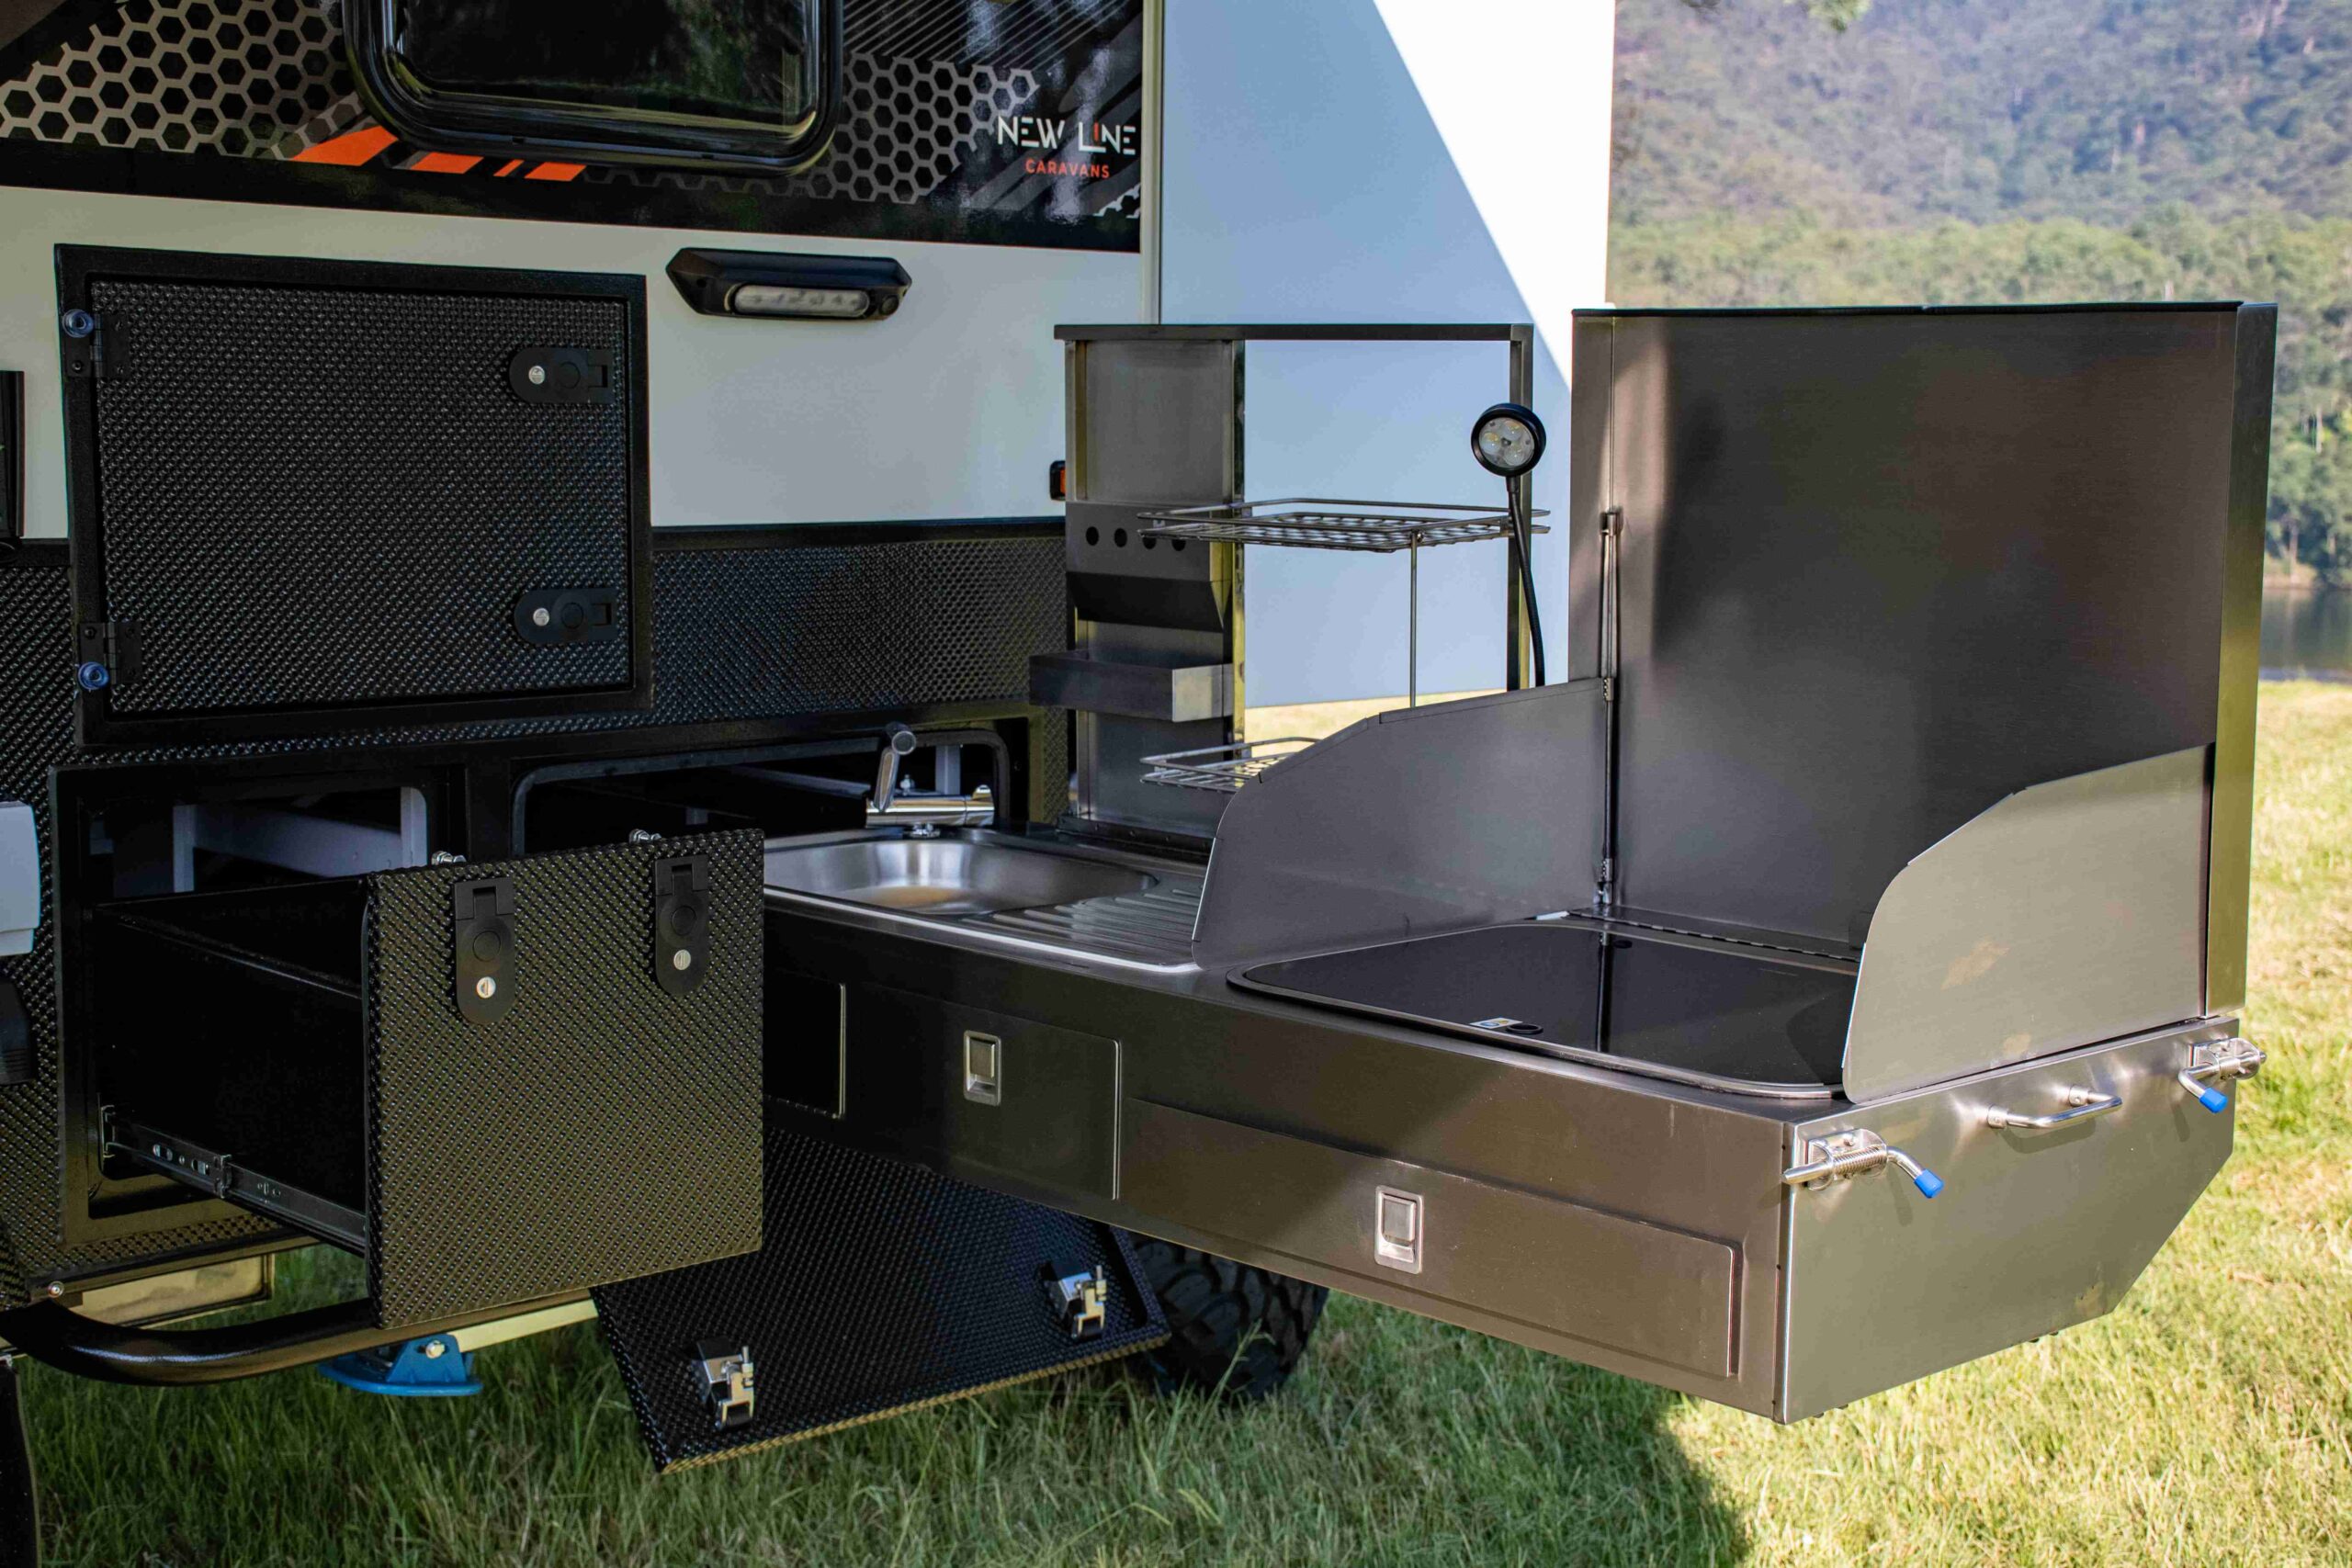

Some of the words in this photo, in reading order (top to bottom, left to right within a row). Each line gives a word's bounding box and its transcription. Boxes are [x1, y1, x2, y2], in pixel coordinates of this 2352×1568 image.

[998, 115, 1066, 150] NEW
[1078, 121, 1136, 155] LINE
[1024, 158, 1110, 179] CARAVANS
